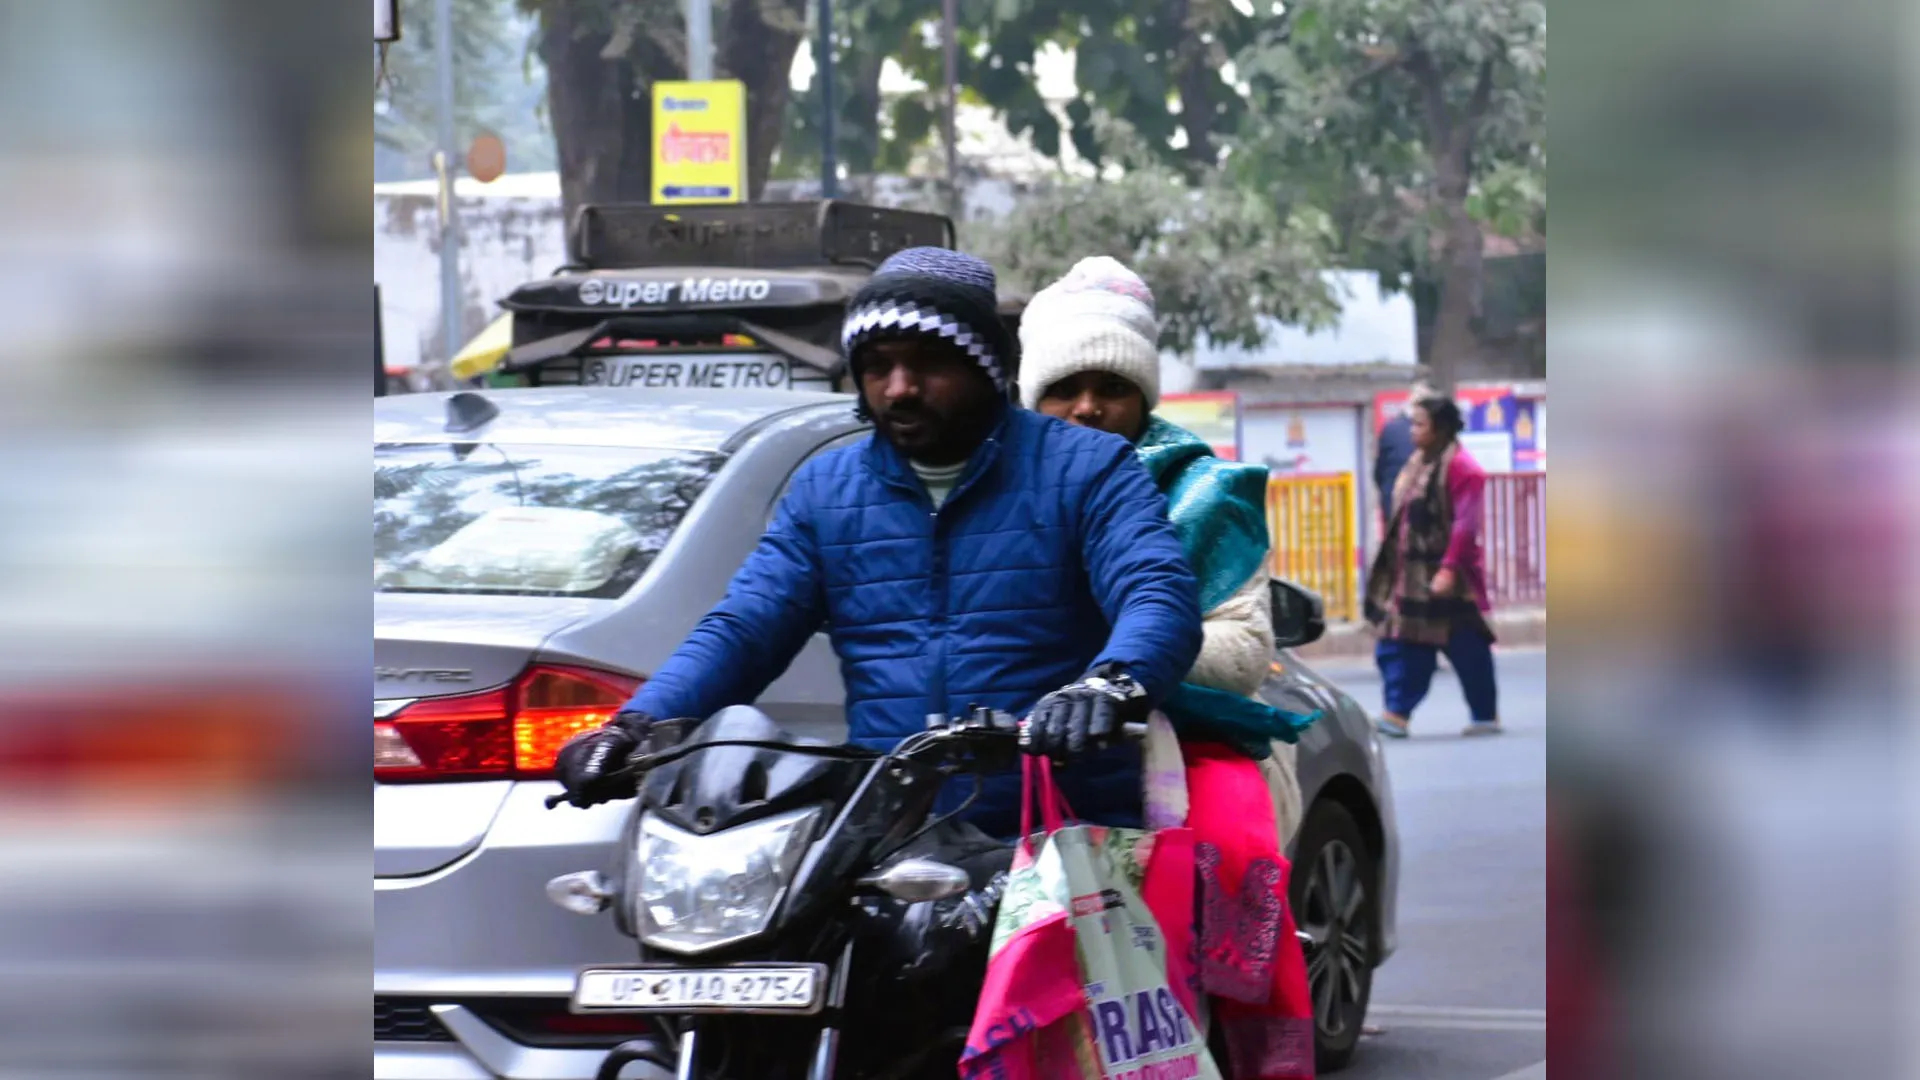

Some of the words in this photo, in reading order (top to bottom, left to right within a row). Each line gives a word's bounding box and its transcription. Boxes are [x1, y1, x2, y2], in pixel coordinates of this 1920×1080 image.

[579, 279, 674, 309] Super
[679, 278, 770, 303] Metro
[687, 362, 787, 388] METRO
[612, 978, 645, 1001] UP
[739, 976, 807, 1001] 2754
